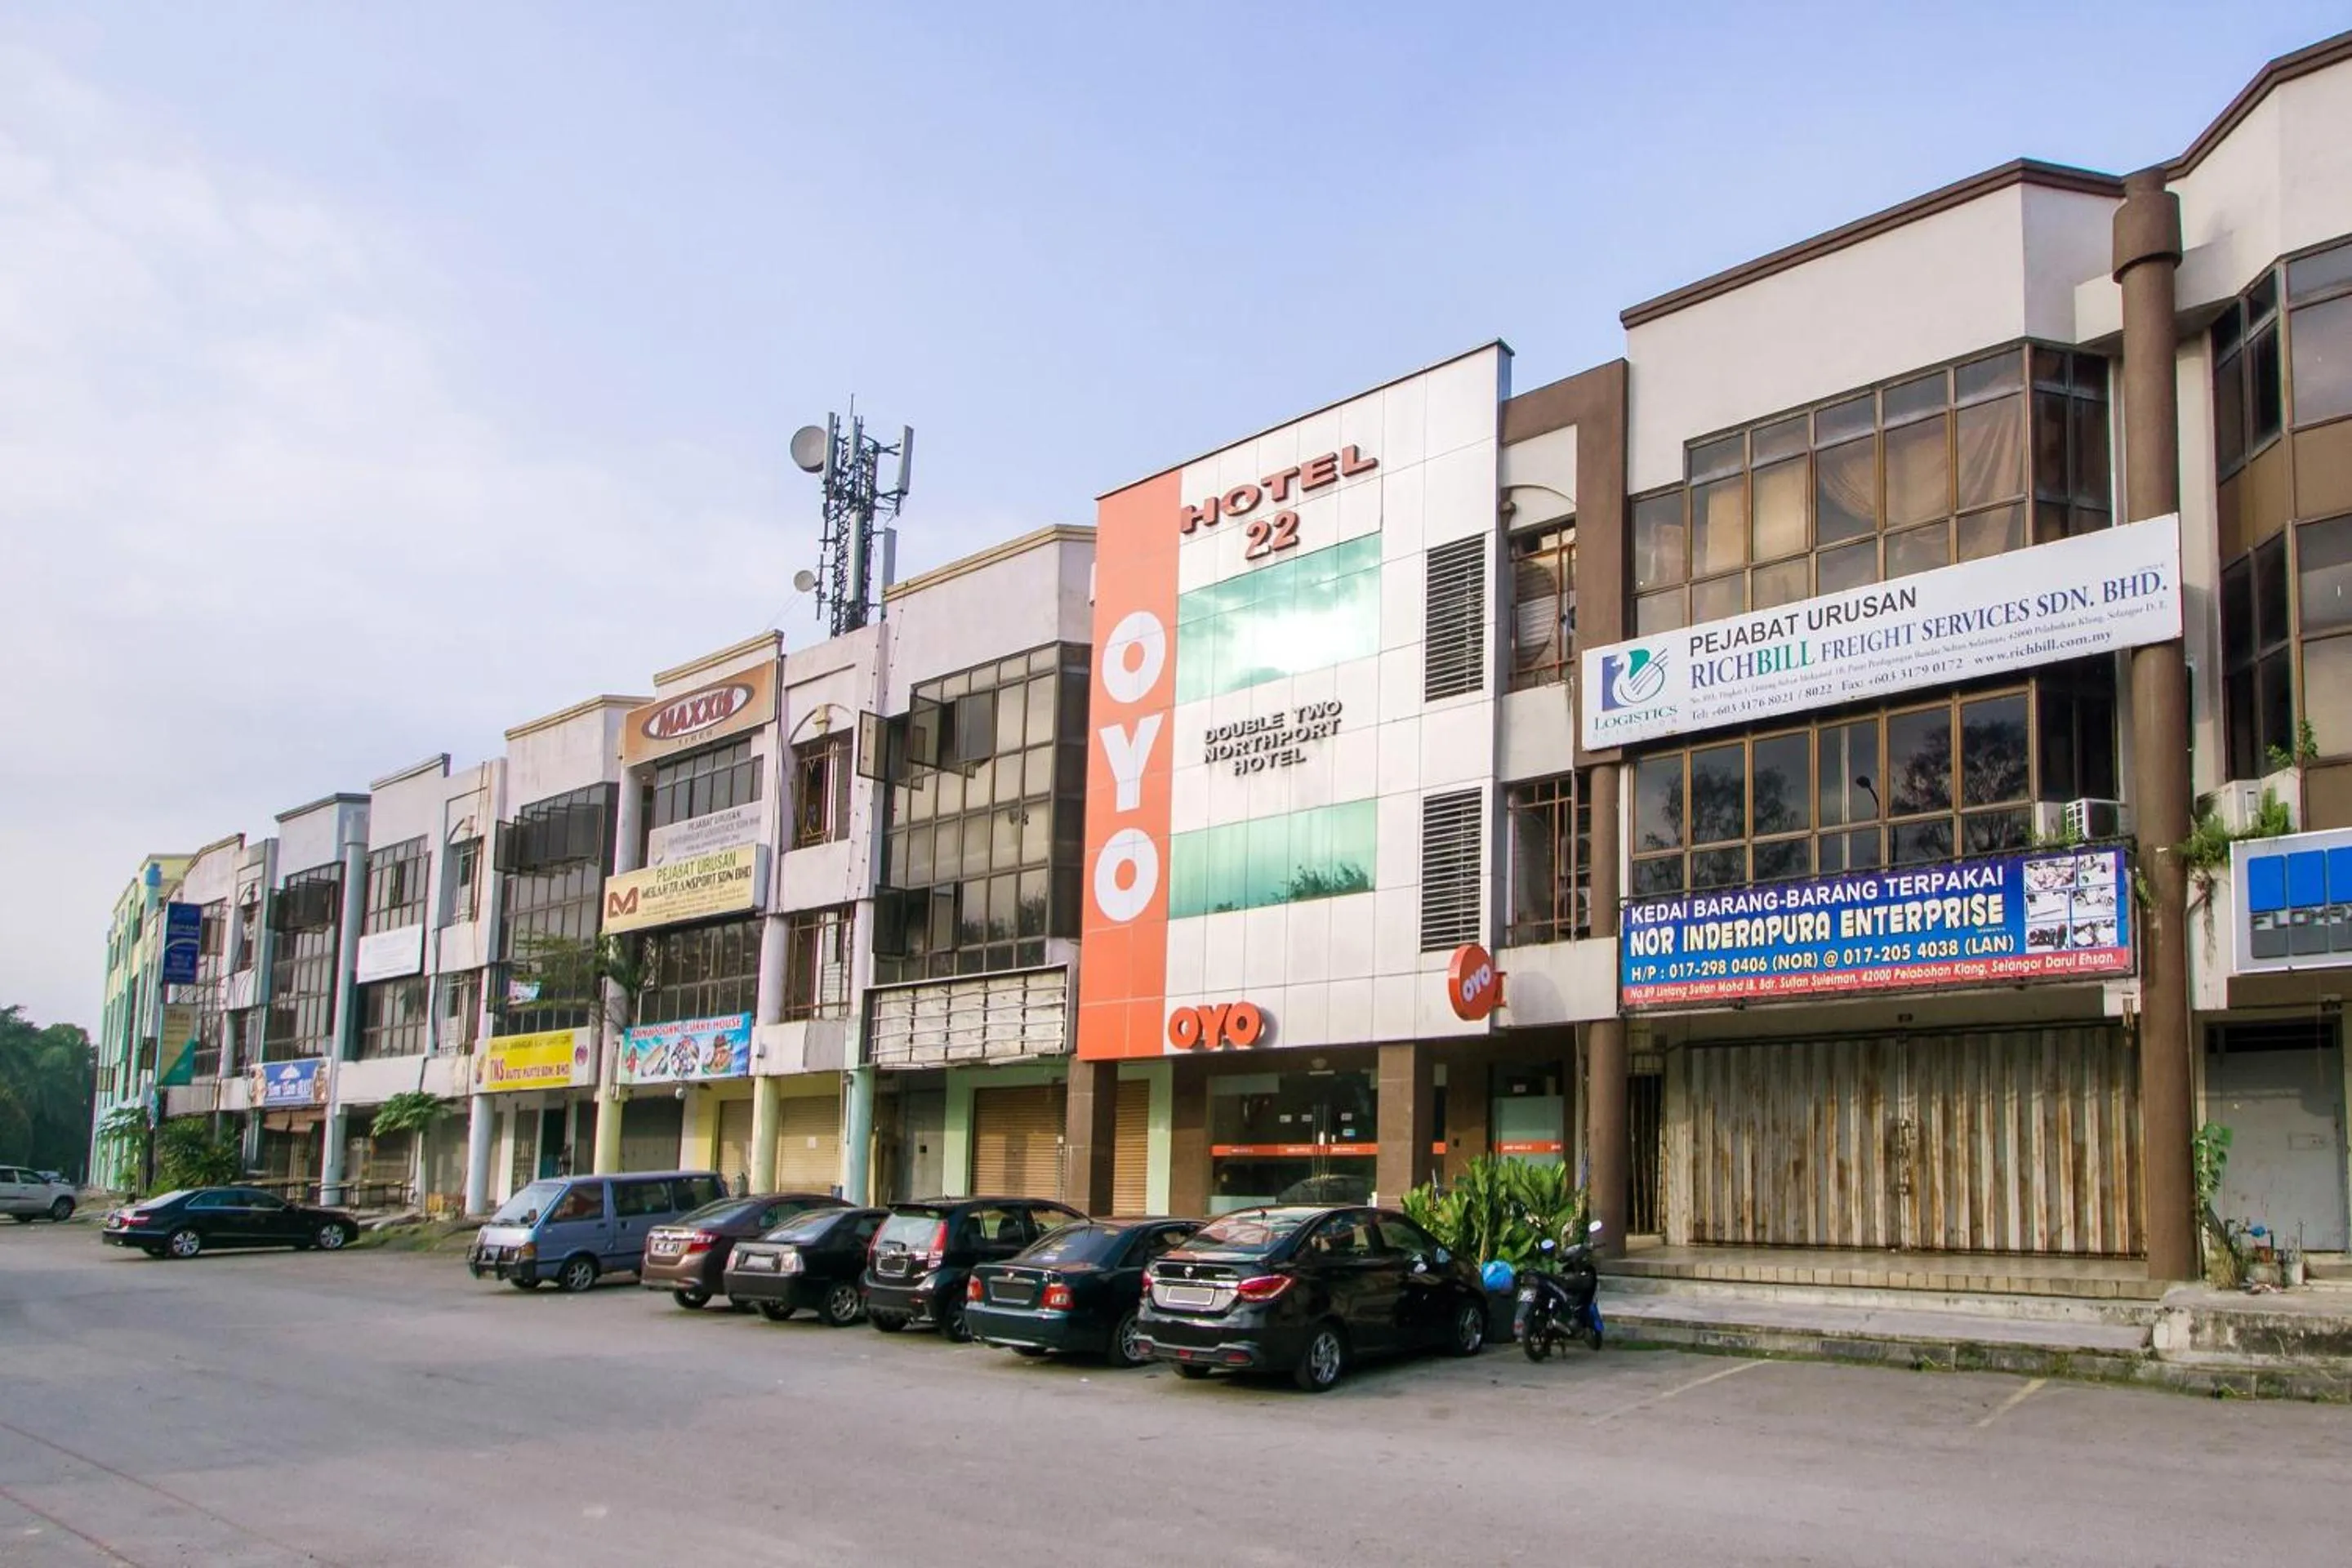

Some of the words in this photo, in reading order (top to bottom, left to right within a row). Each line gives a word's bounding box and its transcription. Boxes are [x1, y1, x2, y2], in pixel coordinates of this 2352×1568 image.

[1180, 443, 1379, 535] HOTEL
[1245, 511, 1299, 560] 22
[1690, 613, 1799, 657] PEJABAT
[1807, 586, 1916, 630] URUSAN
[1691, 640, 1815, 689] RICHBILL
[1821, 622, 1916, 662] FREIGHT
[1922, 598, 2030, 641] SERVICES
[2036, 586, 2095, 617] SDN.
[2103, 571, 2167, 603] BHD.
[1204, 718, 1342, 764] NORTHPORT
[1205, 712, 1285, 744] DOUBLE
[1293, 700, 1343, 724] TWO
[1594, 706, 1678, 730] LOGISTICS
[1233, 748, 1307, 777] HOTEL
[657, 862, 695, 883] PEJABAT
[697, 852, 737, 875] URUSAN
[1632, 903, 1688, 924] KEDAI
[1694, 880, 1878, 918] BARANG-BARANG
[1885, 865, 2003, 898] TERPAKAI
[1630, 925, 1675, 957] NOR
[1683, 911, 1831, 952] INDERAPURA
[1840, 893, 2003, 938] ENTERPRISE
[1669, 959, 1727, 978] 017-298
[1731, 956, 1767, 973] 0406
[1772, 951, 1818, 972] (NOR)
[1823, 950, 1838, 968] @
[1843, 943, 1911, 965] 017-205
[1917, 939, 1959, 958] 4038
[1965, 934, 2015, 956] (LAN)
[1991, 958, 2042, 973] Selangor
[2045, 954, 2076, 969] Darul
[1462, 962, 1491, 1004] OYO
[1168, 1001, 1263, 1050] OYO
